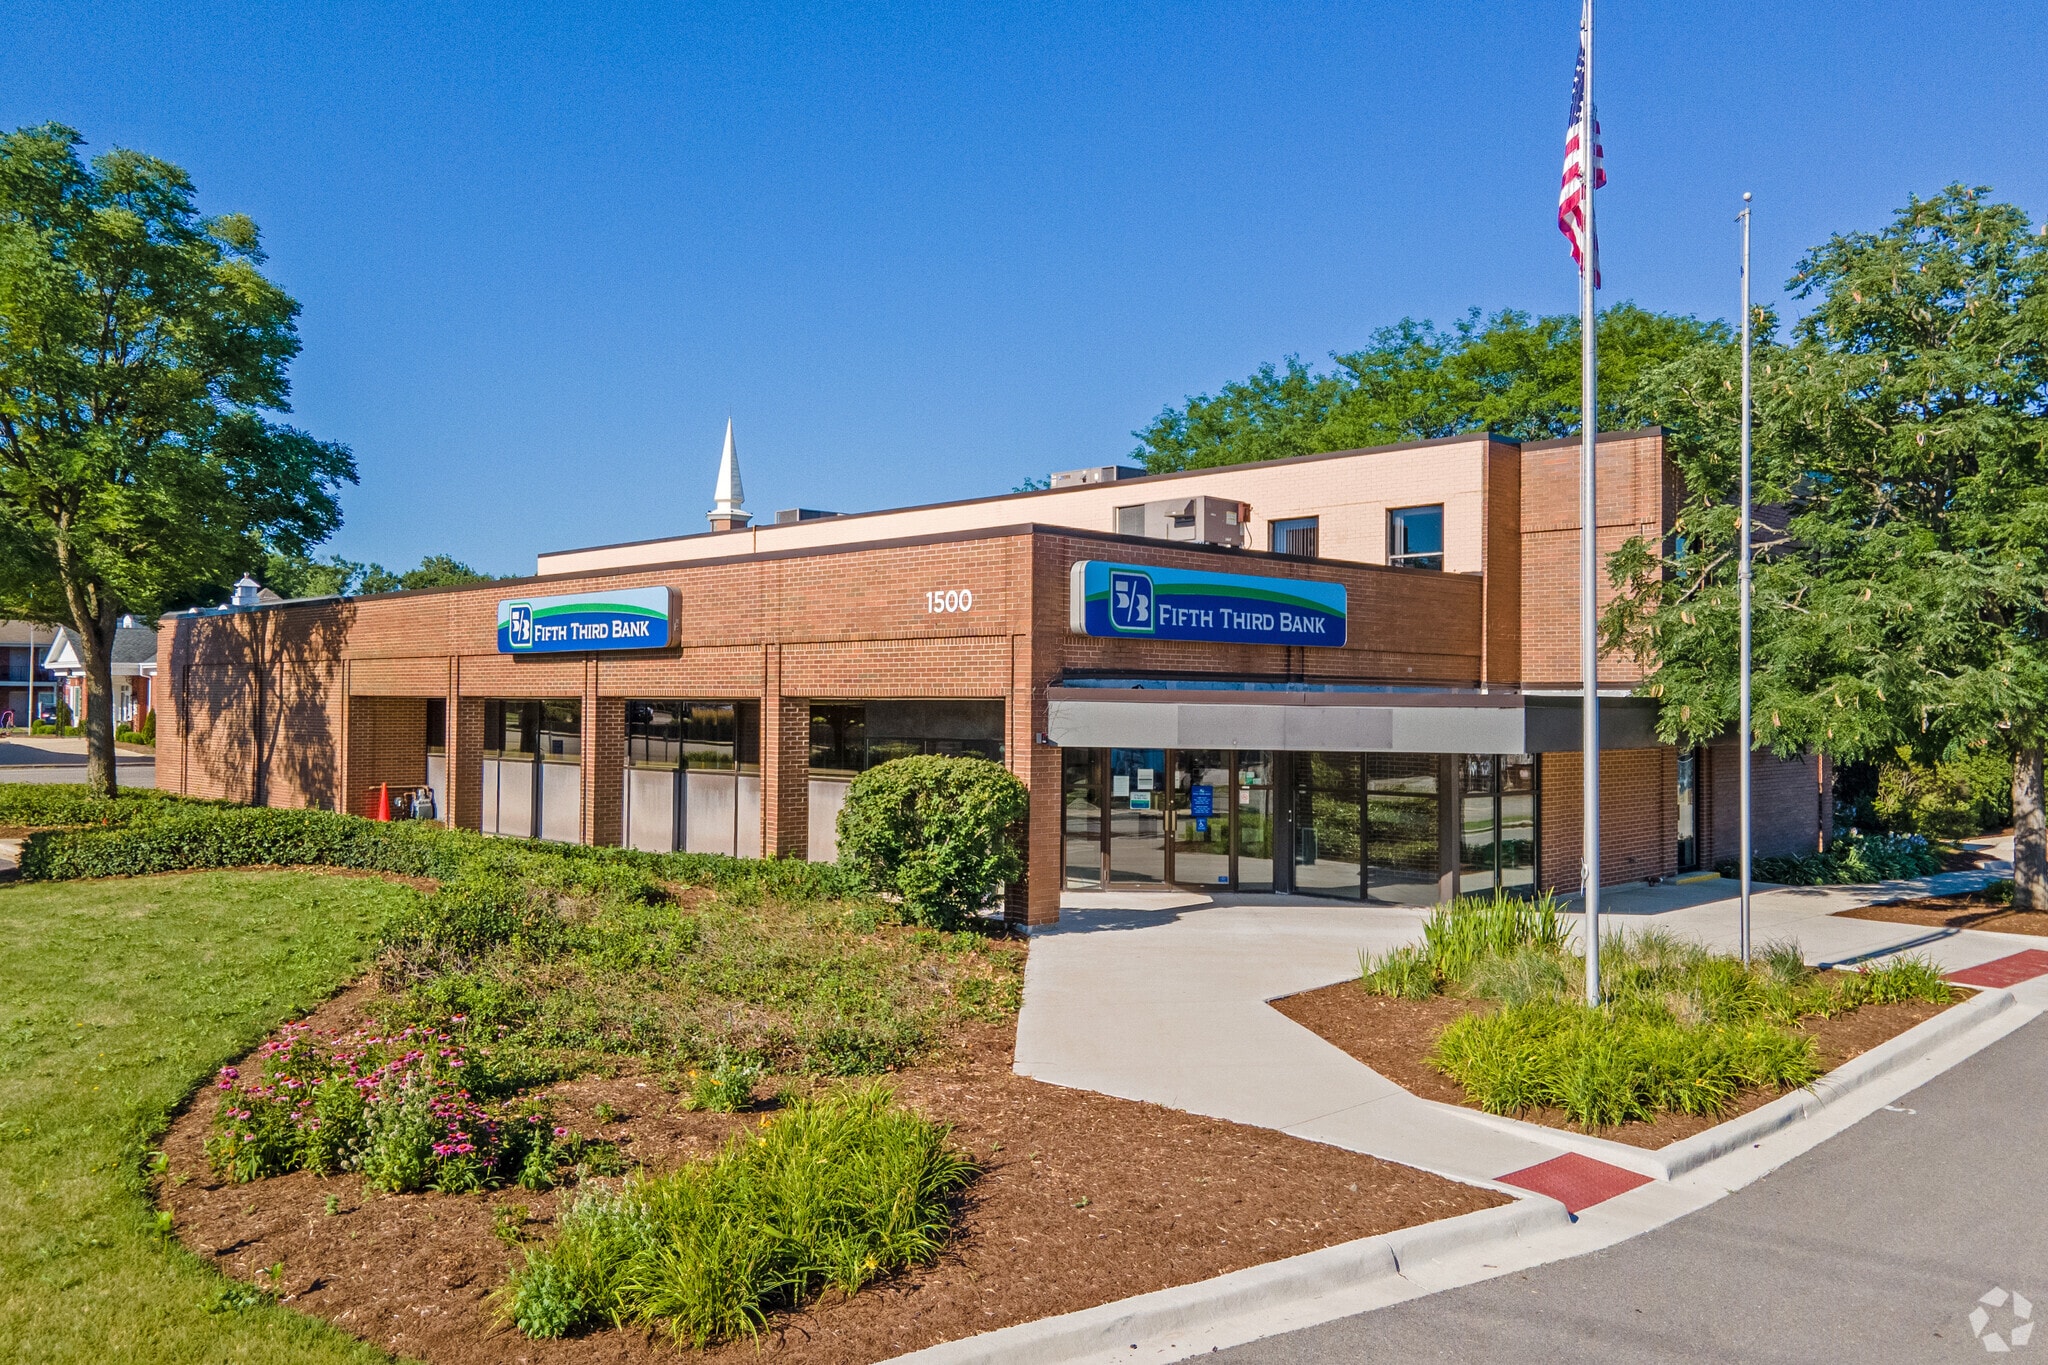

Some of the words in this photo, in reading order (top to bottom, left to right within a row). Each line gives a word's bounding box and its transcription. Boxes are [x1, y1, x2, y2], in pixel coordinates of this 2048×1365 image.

[925, 588, 973, 614] 1500
[534, 624, 567, 642] FIFTH
[570, 622, 609, 640] THIRD
[611, 620, 650, 638] BANK
[1158, 604, 1213, 628] FIFTH
[1219, 608, 1275, 631] THIRD
[1279, 612, 1326, 634] BANK
